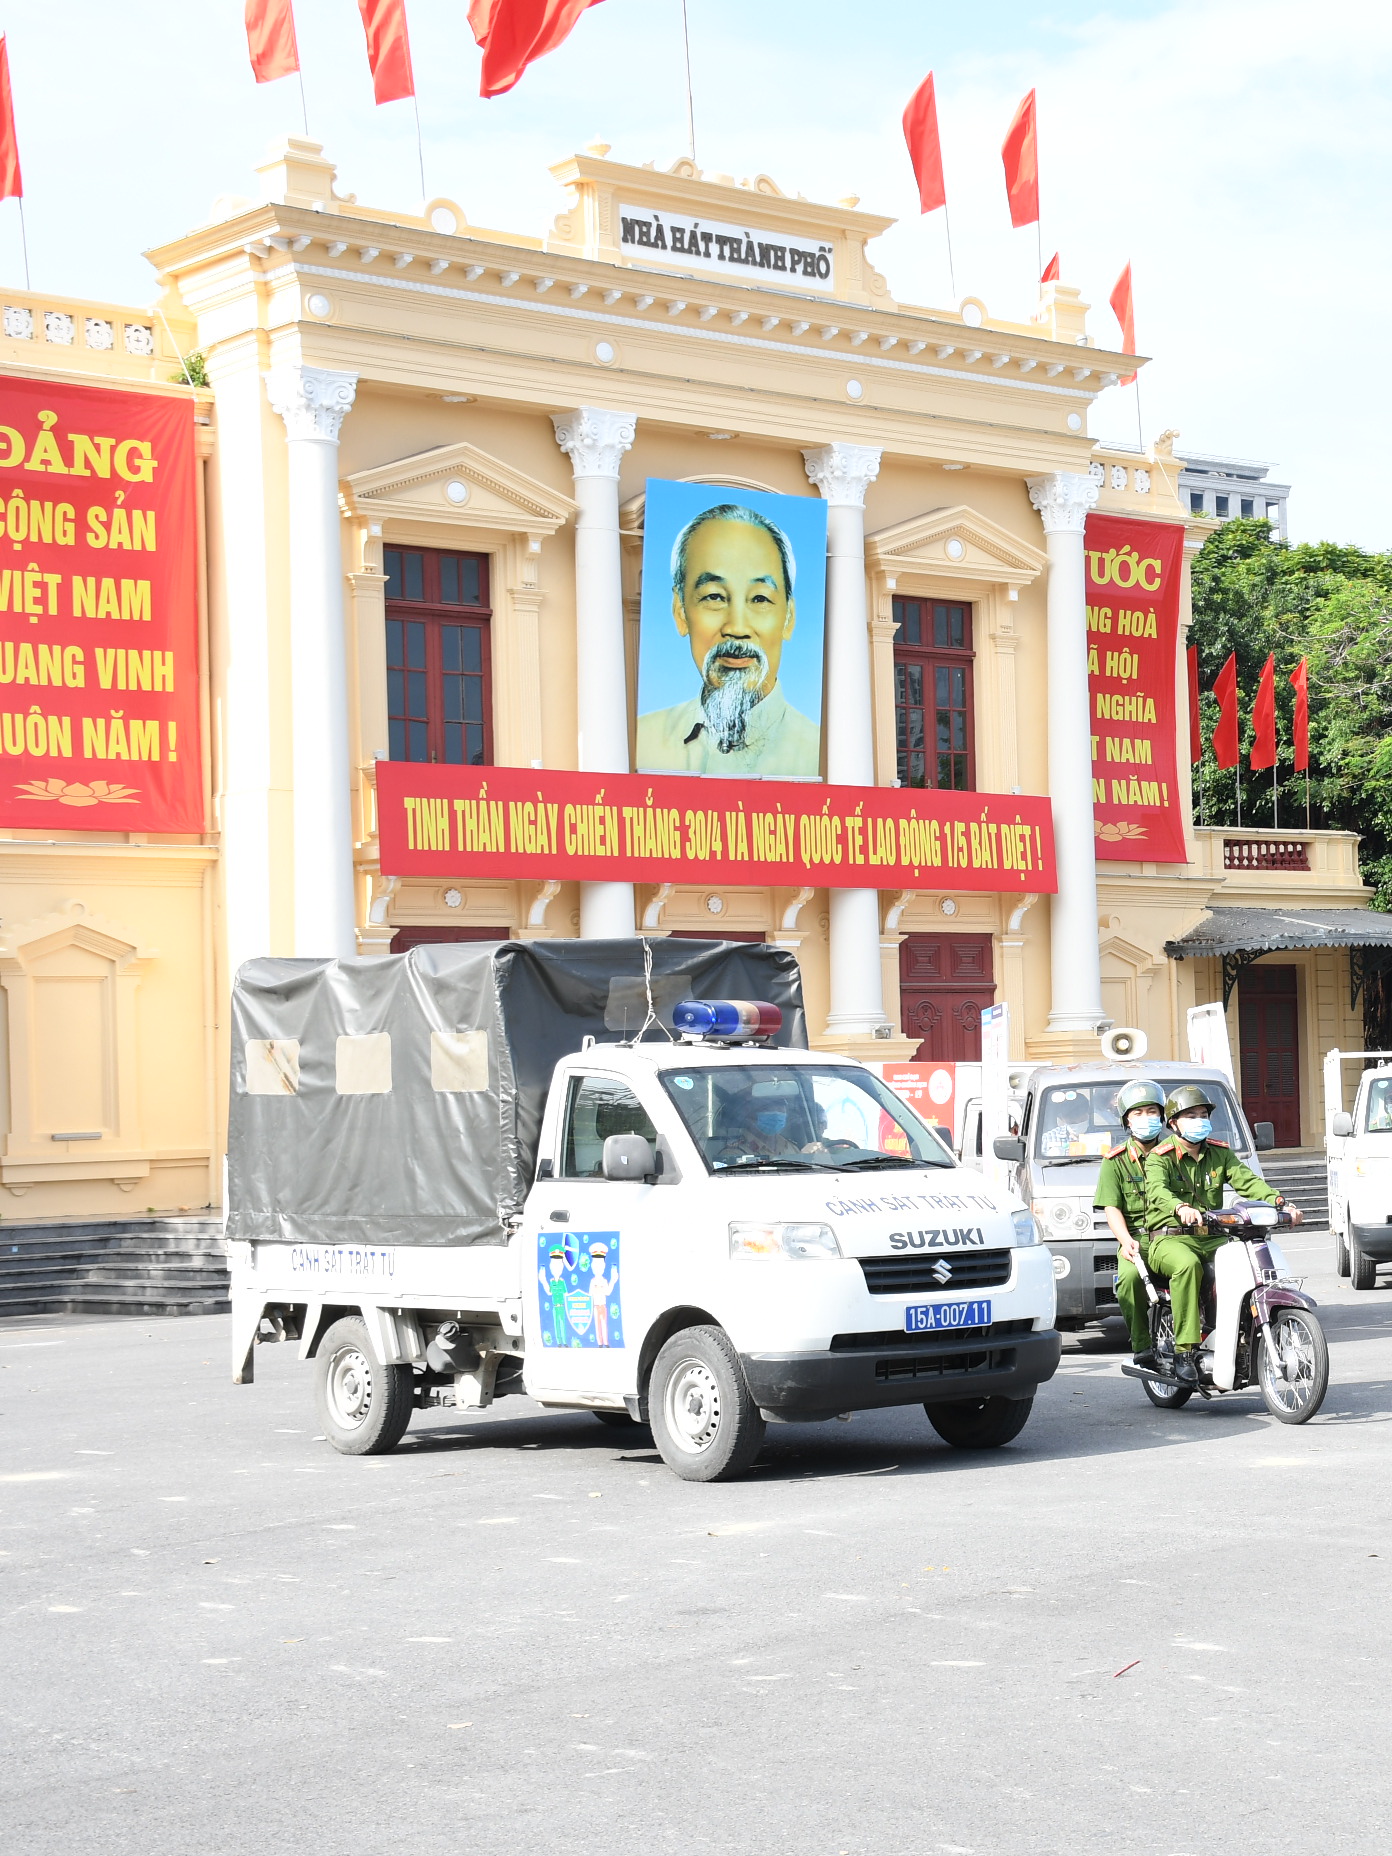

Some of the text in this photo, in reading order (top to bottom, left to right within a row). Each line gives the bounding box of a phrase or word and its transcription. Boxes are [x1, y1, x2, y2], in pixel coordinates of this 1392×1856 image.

[621, 214, 833, 280] NHÀ HÁT THÀNH PHỐ
[0, 410, 158, 483] ĐẢNG
[0, 489, 157, 552] ỘNG SẢN
[1084, 545, 1162, 592] ƯỚC
[72, 575, 152, 621] NAM
[1086, 605, 1158, 639] NG HOÀ
[0, 641, 174, 692] UANG VINH
[1105, 647, 1139, 684] HỘI
[1096, 691, 1157, 724] NGHĨA
[0, 705, 73, 758] UÔN
[1105, 736, 1153, 765] NAM
[404, 797, 450, 851] TINH
[453, 781, 505, 853] THẦN
[508, 791, 558, 855] NGÀY
[564, 788, 619, 857] CHIẾN
[622, 788, 681, 859] THẮNG
[685, 809, 723, 861] 30/4
[725, 801, 749, 861] VÀ
[752, 802, 795, 863] NGÀY
[799, 798, 842, 869] QUỐC
[845, 801, 865, 865] TẾ
[867, 817, 896, 866] LAO
[899, 809, 942, 877] ĐỘNG
[944, 820, 968, 868] 1/5
[970, 806, 999, 869] BẤT
[889, 1227, 985, 1250] SUZUKI
[909, 1301, 989, 1330] 15A-007.11
